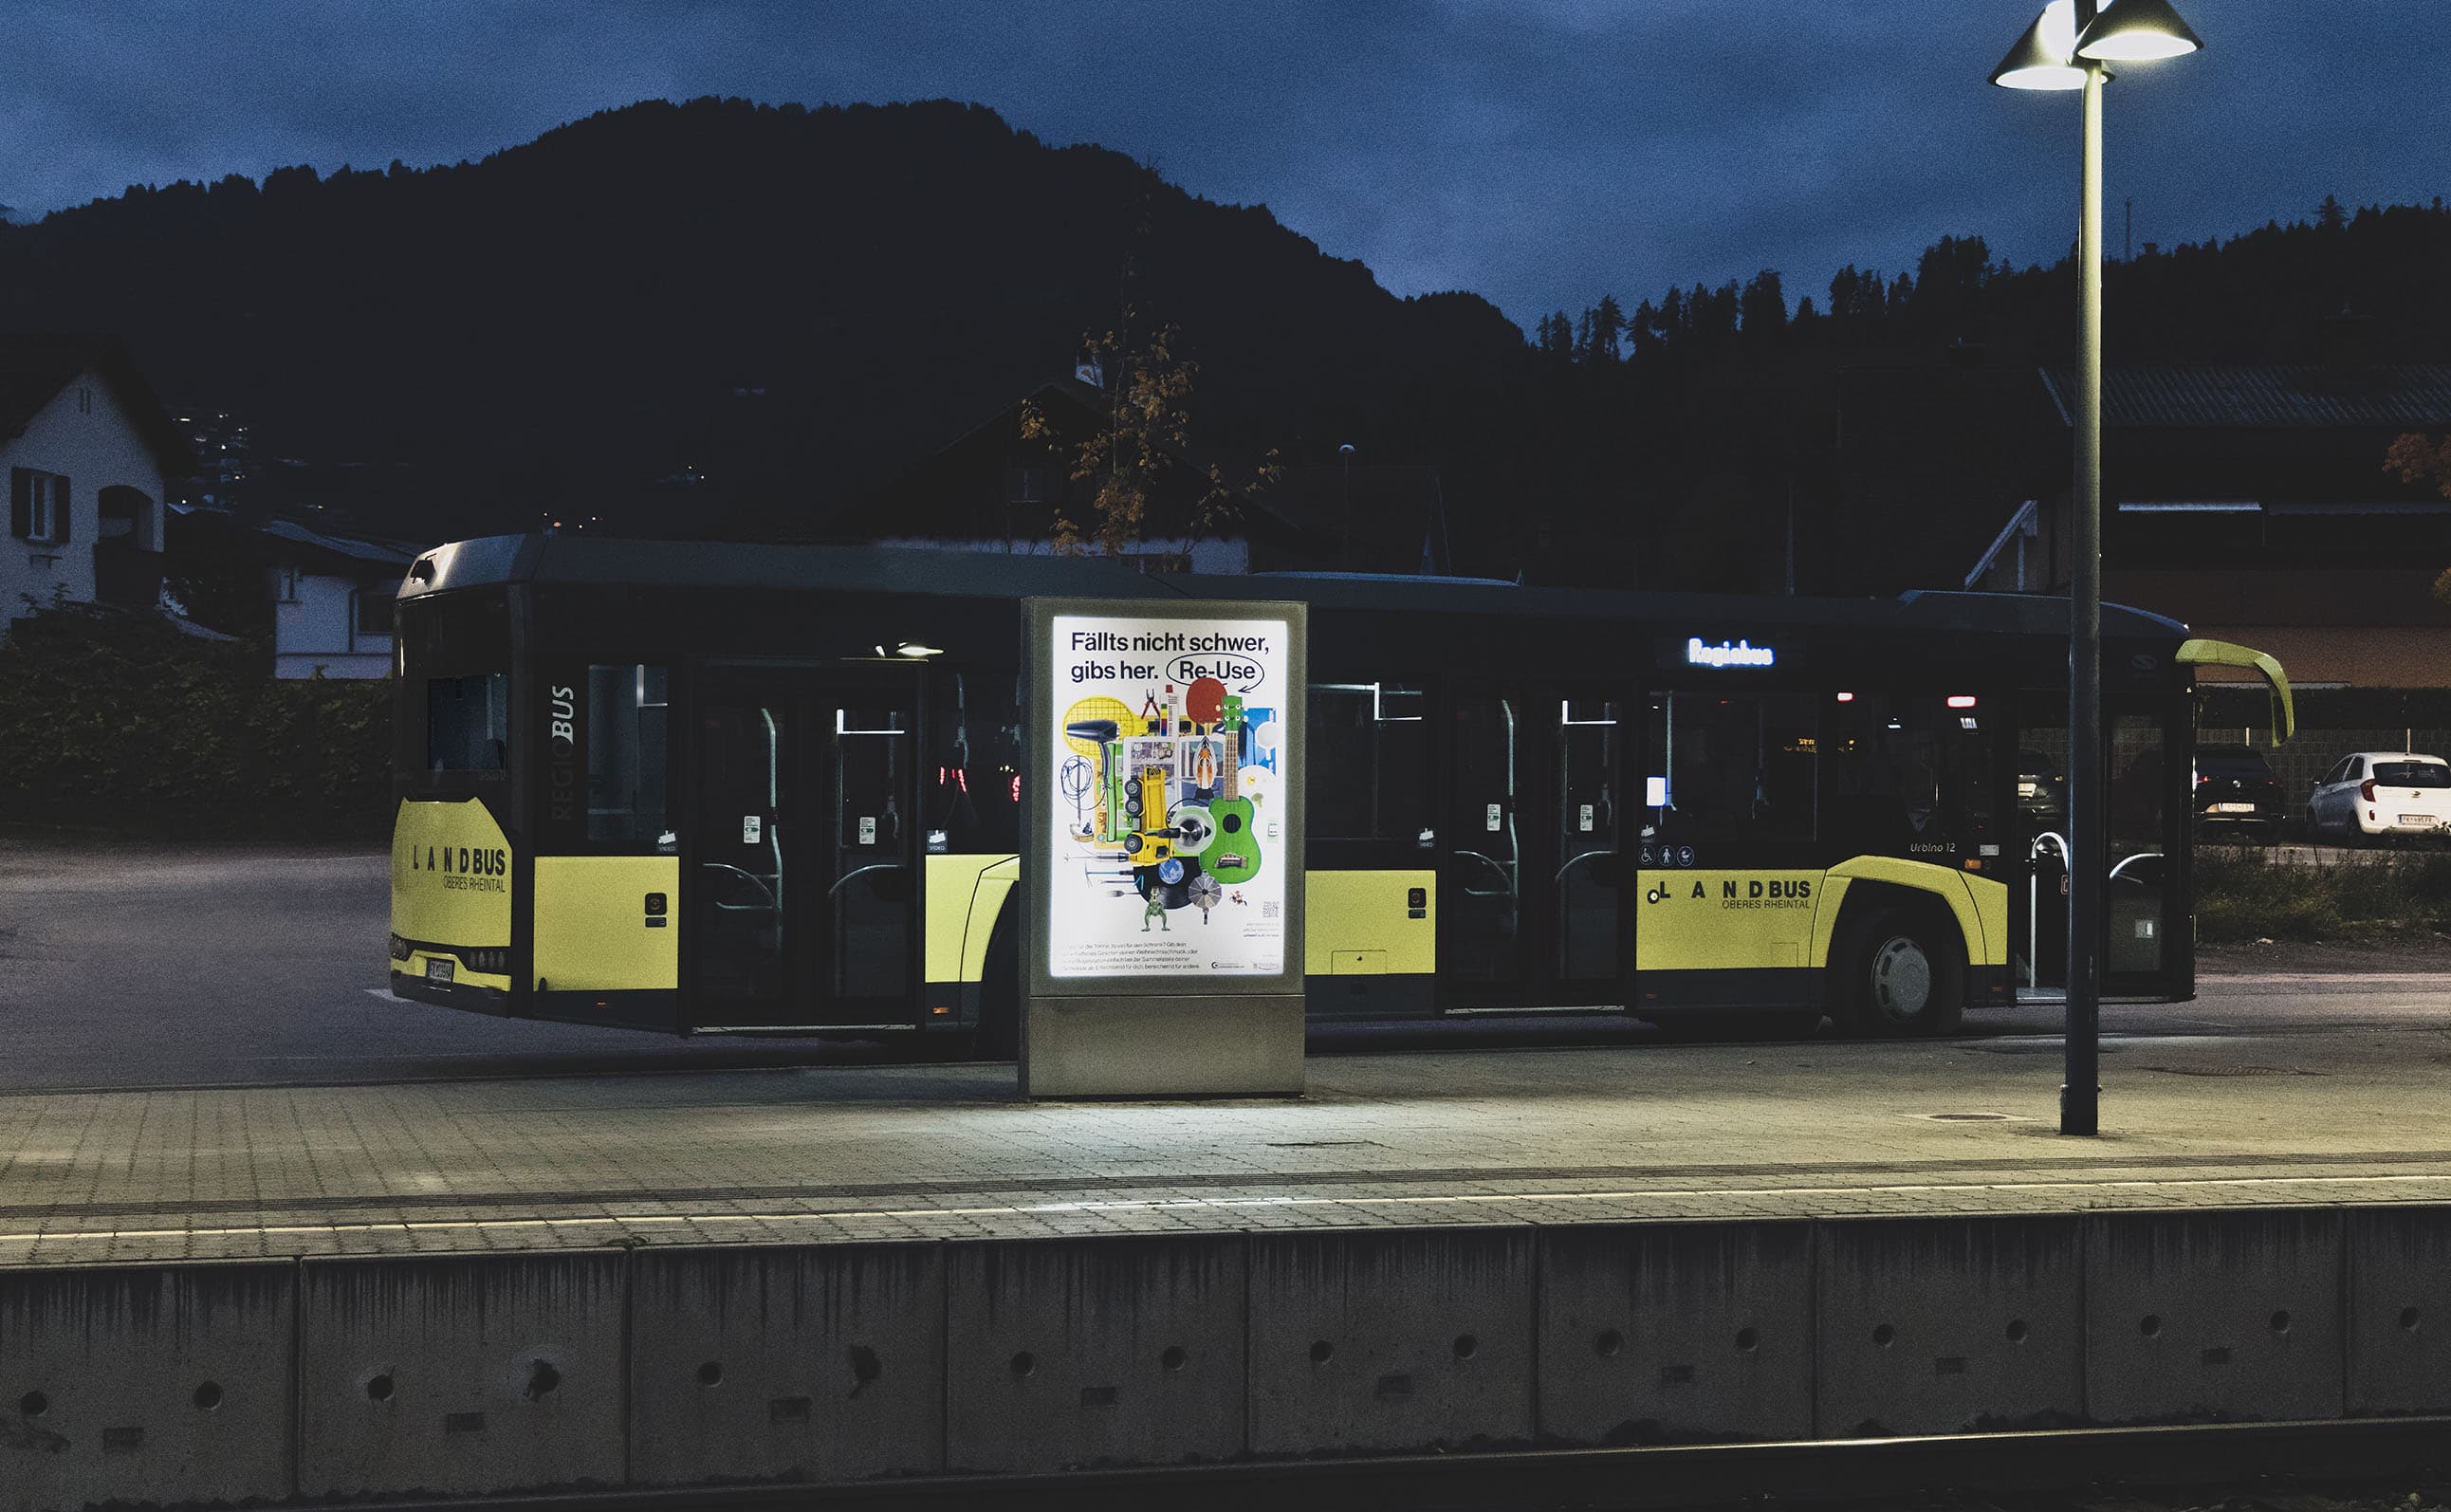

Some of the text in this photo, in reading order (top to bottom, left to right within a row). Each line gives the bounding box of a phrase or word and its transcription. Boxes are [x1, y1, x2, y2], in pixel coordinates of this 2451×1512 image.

[1071, 632, 1270, 655] Fällts nicht schwer,
[1071, 661, 1256, 683] gibs her. Re-Use
[1910, 842, 1956, 853] Urbino 12
[443, 875, 506, 893] OBERES RHEINTAL
[1722, 899, 1810, 910] OBERES RHEINTAL
